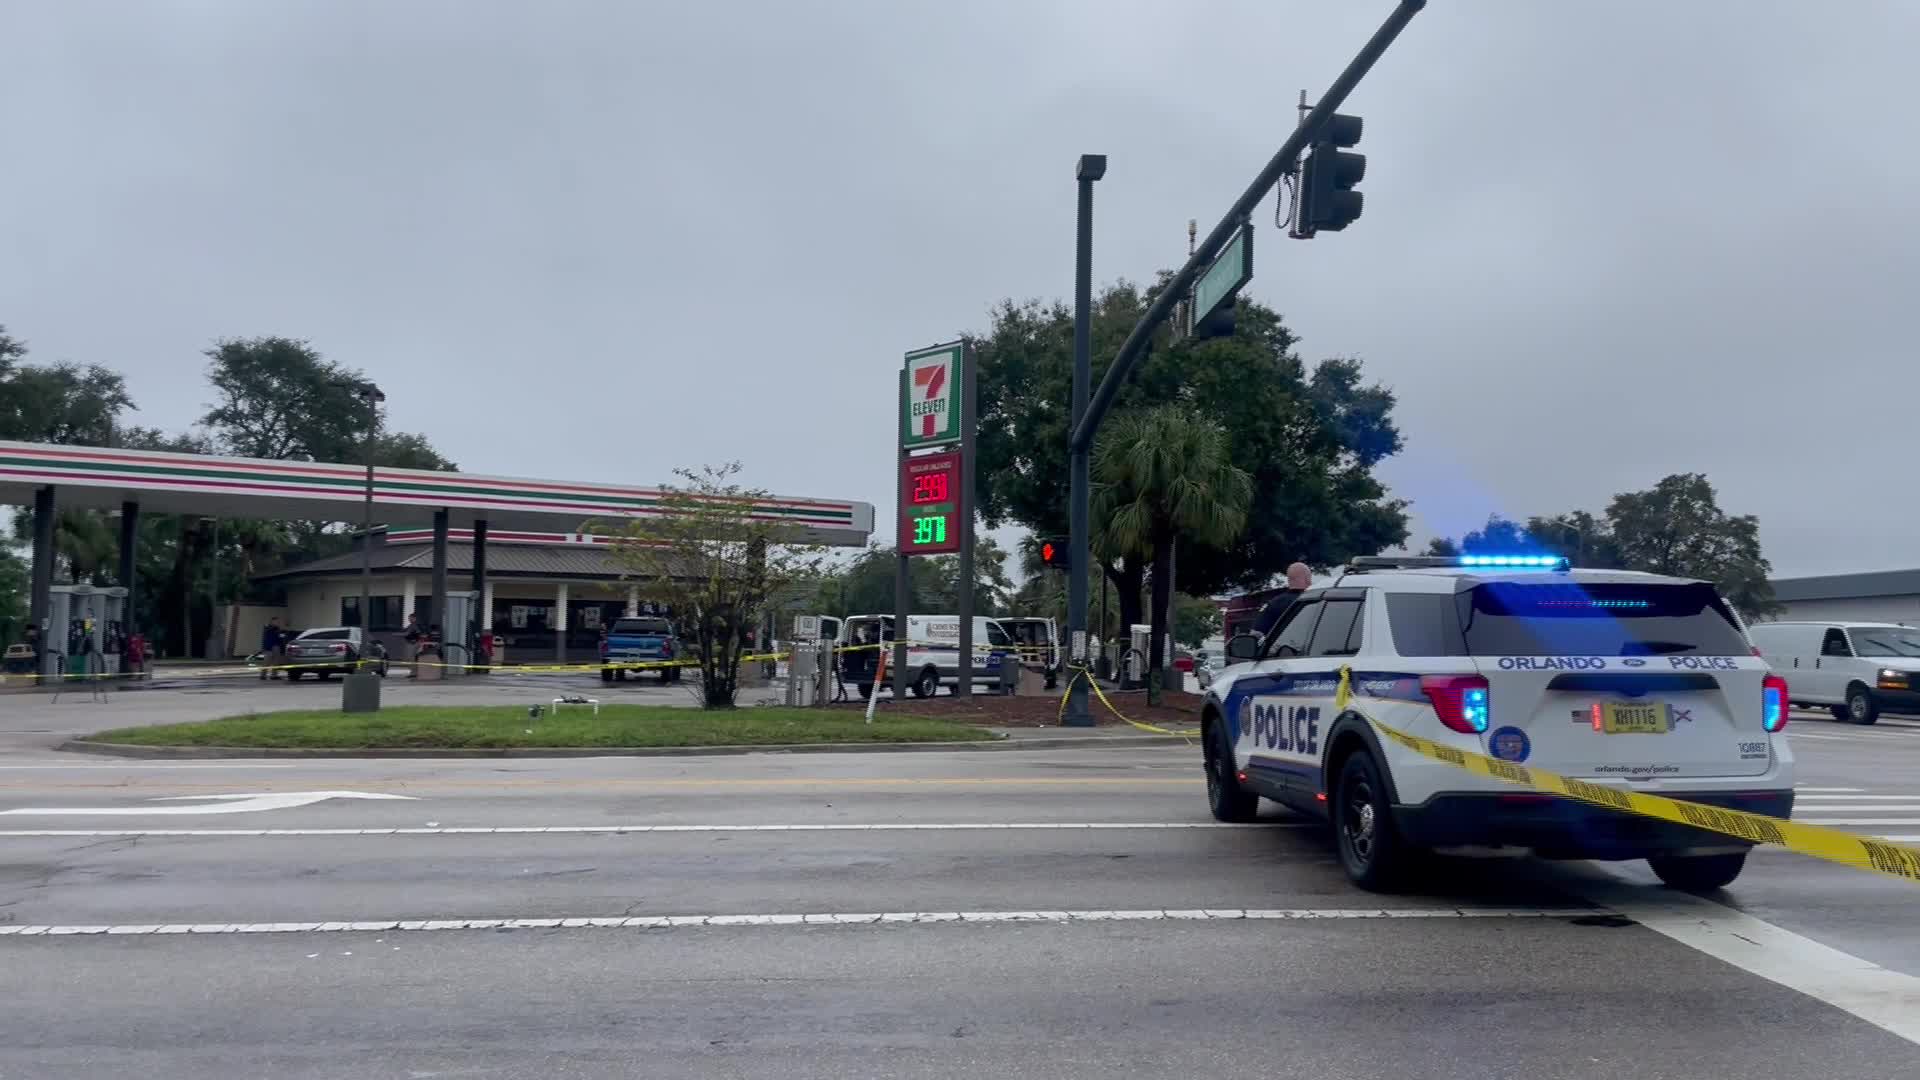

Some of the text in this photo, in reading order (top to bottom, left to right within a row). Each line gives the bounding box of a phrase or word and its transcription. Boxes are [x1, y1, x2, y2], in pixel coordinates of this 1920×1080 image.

[914, 364, 945, 437] 7
[1498, 657, 1738, 670] ORLANDO POLICE
[1254, 704, 1320, 755] POLICE
